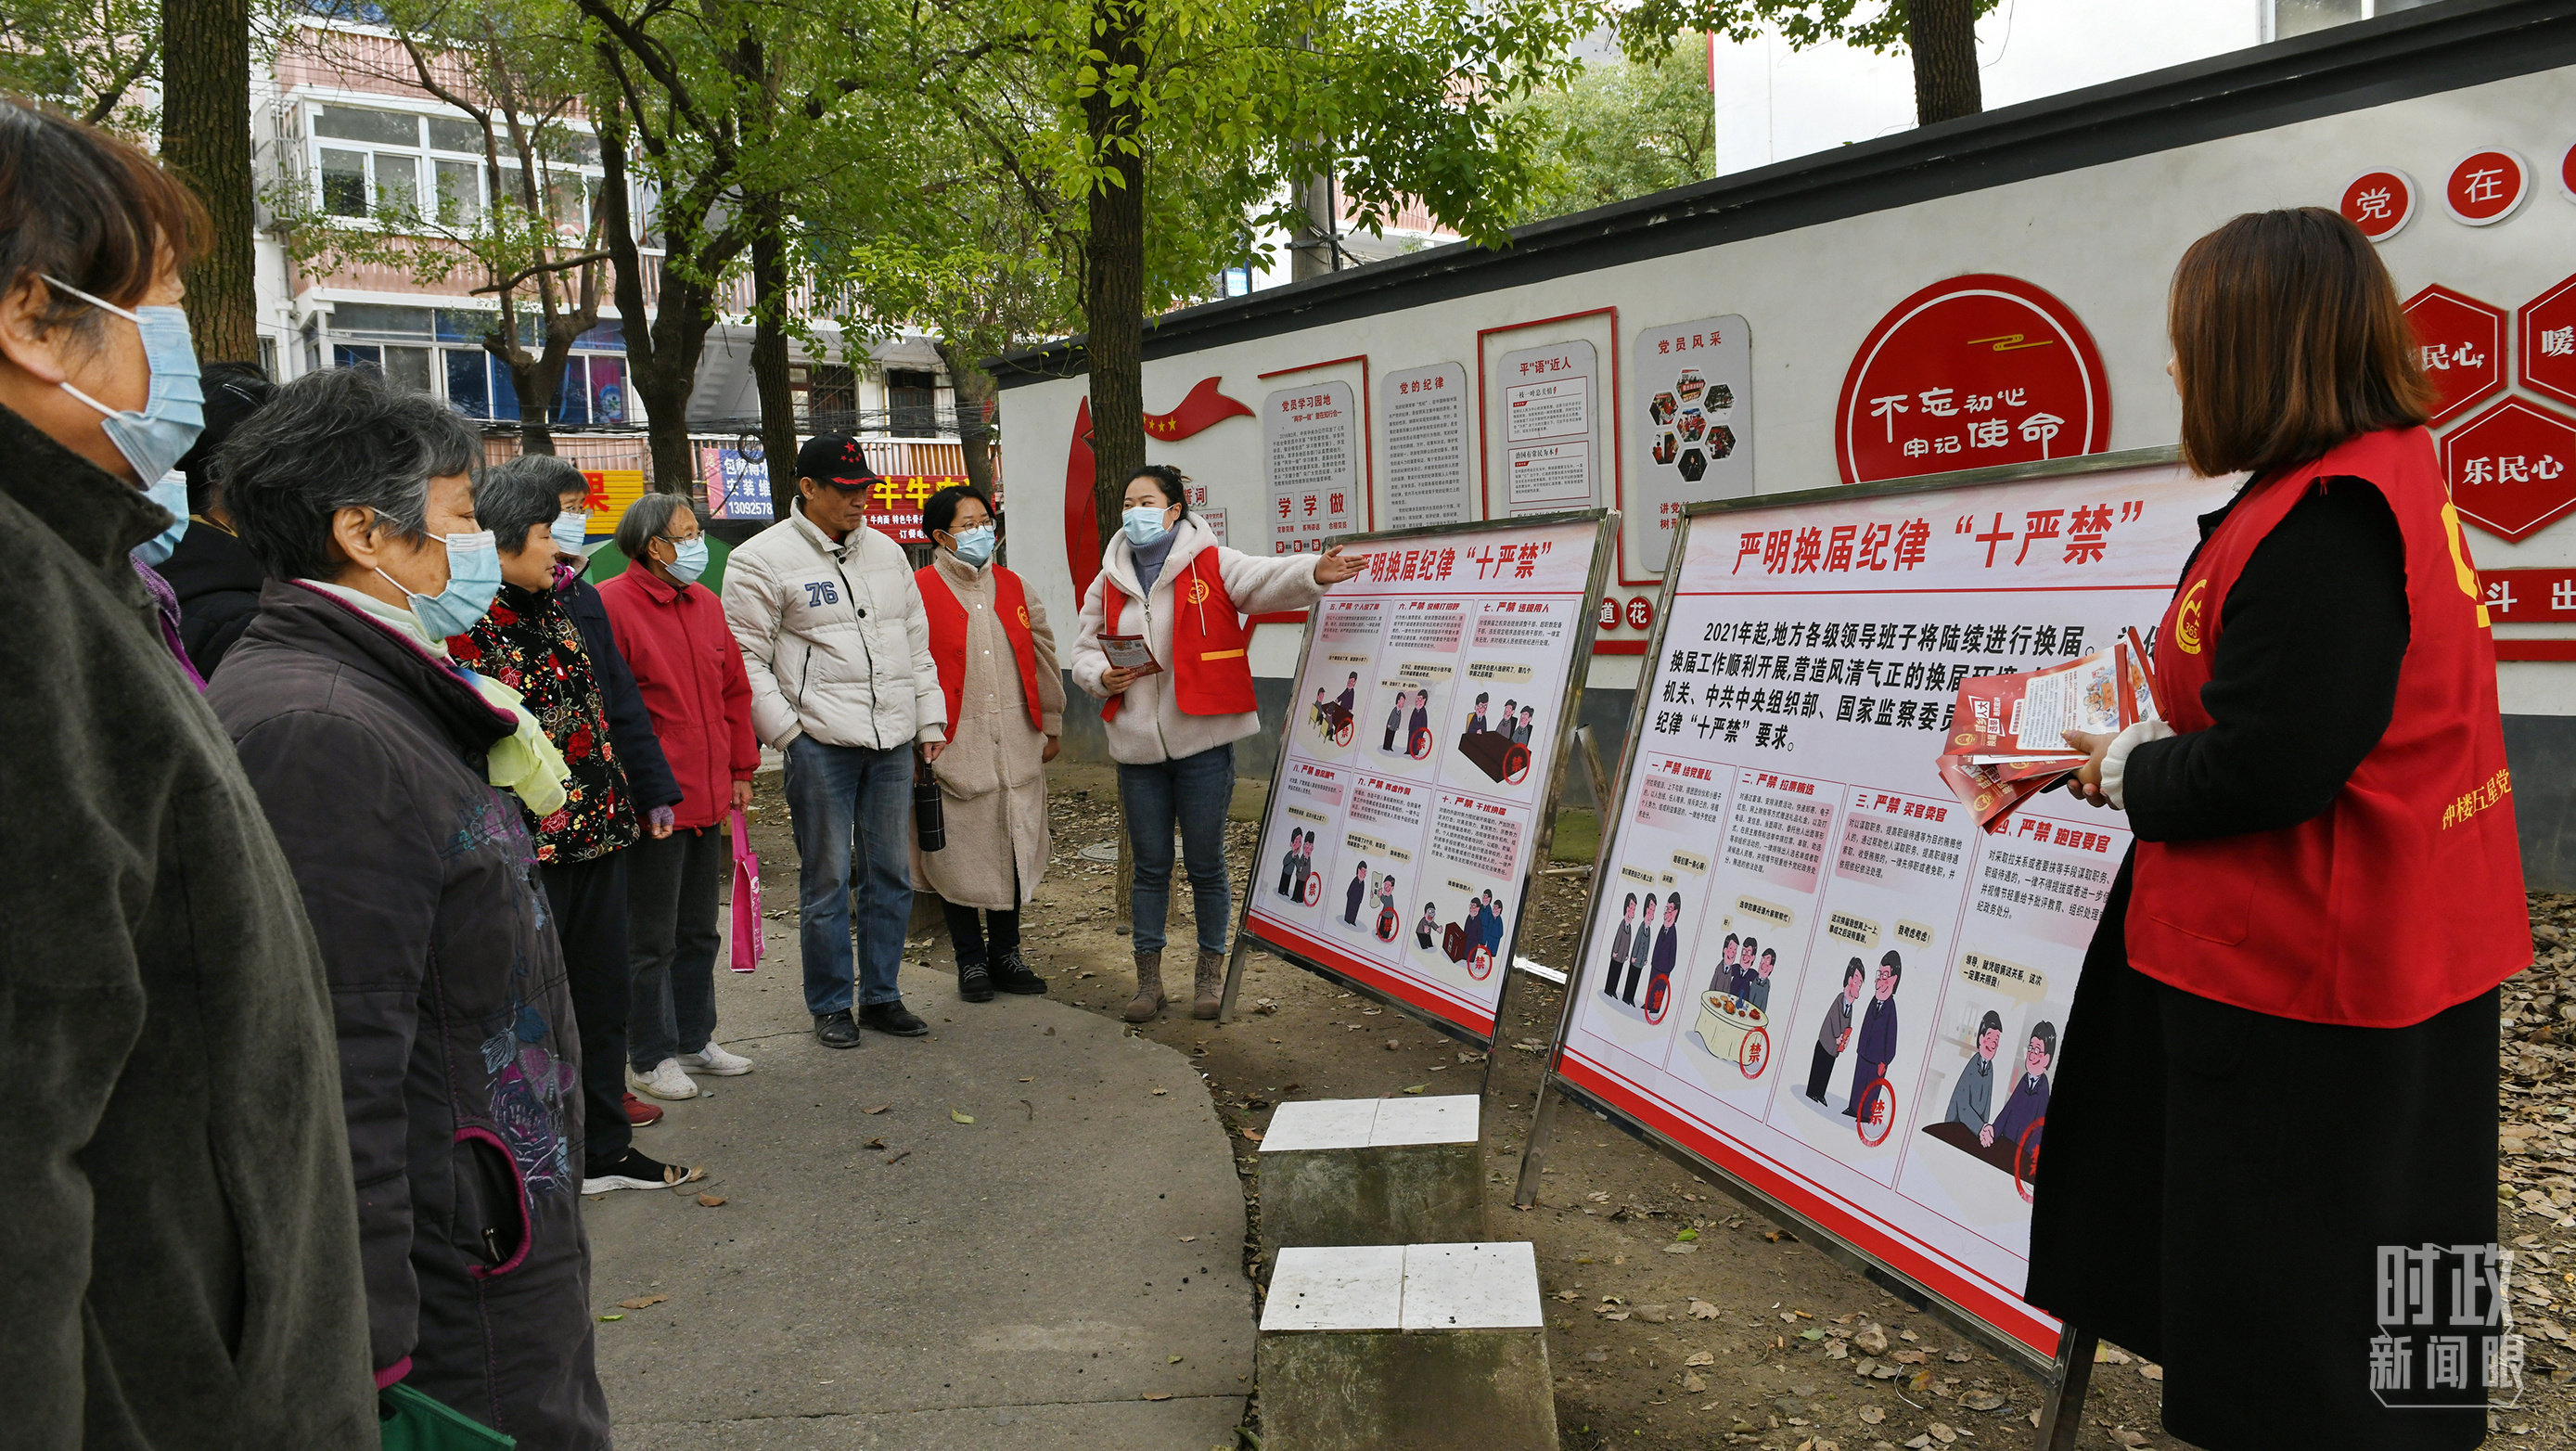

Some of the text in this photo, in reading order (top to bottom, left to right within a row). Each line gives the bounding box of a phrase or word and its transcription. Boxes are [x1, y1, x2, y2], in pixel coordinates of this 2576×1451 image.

[2357, 169, 2503, 222] 党 在
[1658, 331, 1722, 354] 党员风采
[2542, 326, 2576, 356] 暖
[1400, 377, 1443, 394] 党的纪律
[1282, 394, 1331, 412] 党员学习园地
[1870, 388, 2028, 443] 不忘初心
[1903, 412, 2065, 460] 牢记使命
[2463, 455, 2564, 484] 乐民心
[873, 476, 969, 509] 牛牛
[729, 502, 773, 515] 13092578
[1279, 493, 1344, 518] 学 学 做
[870, 515, 890, 524] 牛肉面
[1329, 521, 1347, 530] 合格党员
[899, 530, 928, 539] 订餐电
[805, 582, 839, 607] 76
[2485, 581, 2518, 613] 斗
[1518, 604, 1549, 612] 违规用人
[1599, 602, 1647, 623] 道 花
[2185, 622, 2197, 638] 365
[1670, 649, 2017, 692] 换届工作顺利开展,营造风清气正的换届
[1683, 765, 1712, 781] 结党营私
[1780, 779, 1814, 795] 拉票贿选
[1855, 794, 1947, 822] 三、严禁 买官卖官
[2054, 828, 2111, 854] 跑官要官
[1977, 901, 2012, 919] 纪政务处分。
[1475, 957, 1485, 969] 禁
[1653, 989, 1662, 1009] 禁
[1749, 1043, 1762, 1063] 禁
[1868, 1099, 1885, 1126] 禁
